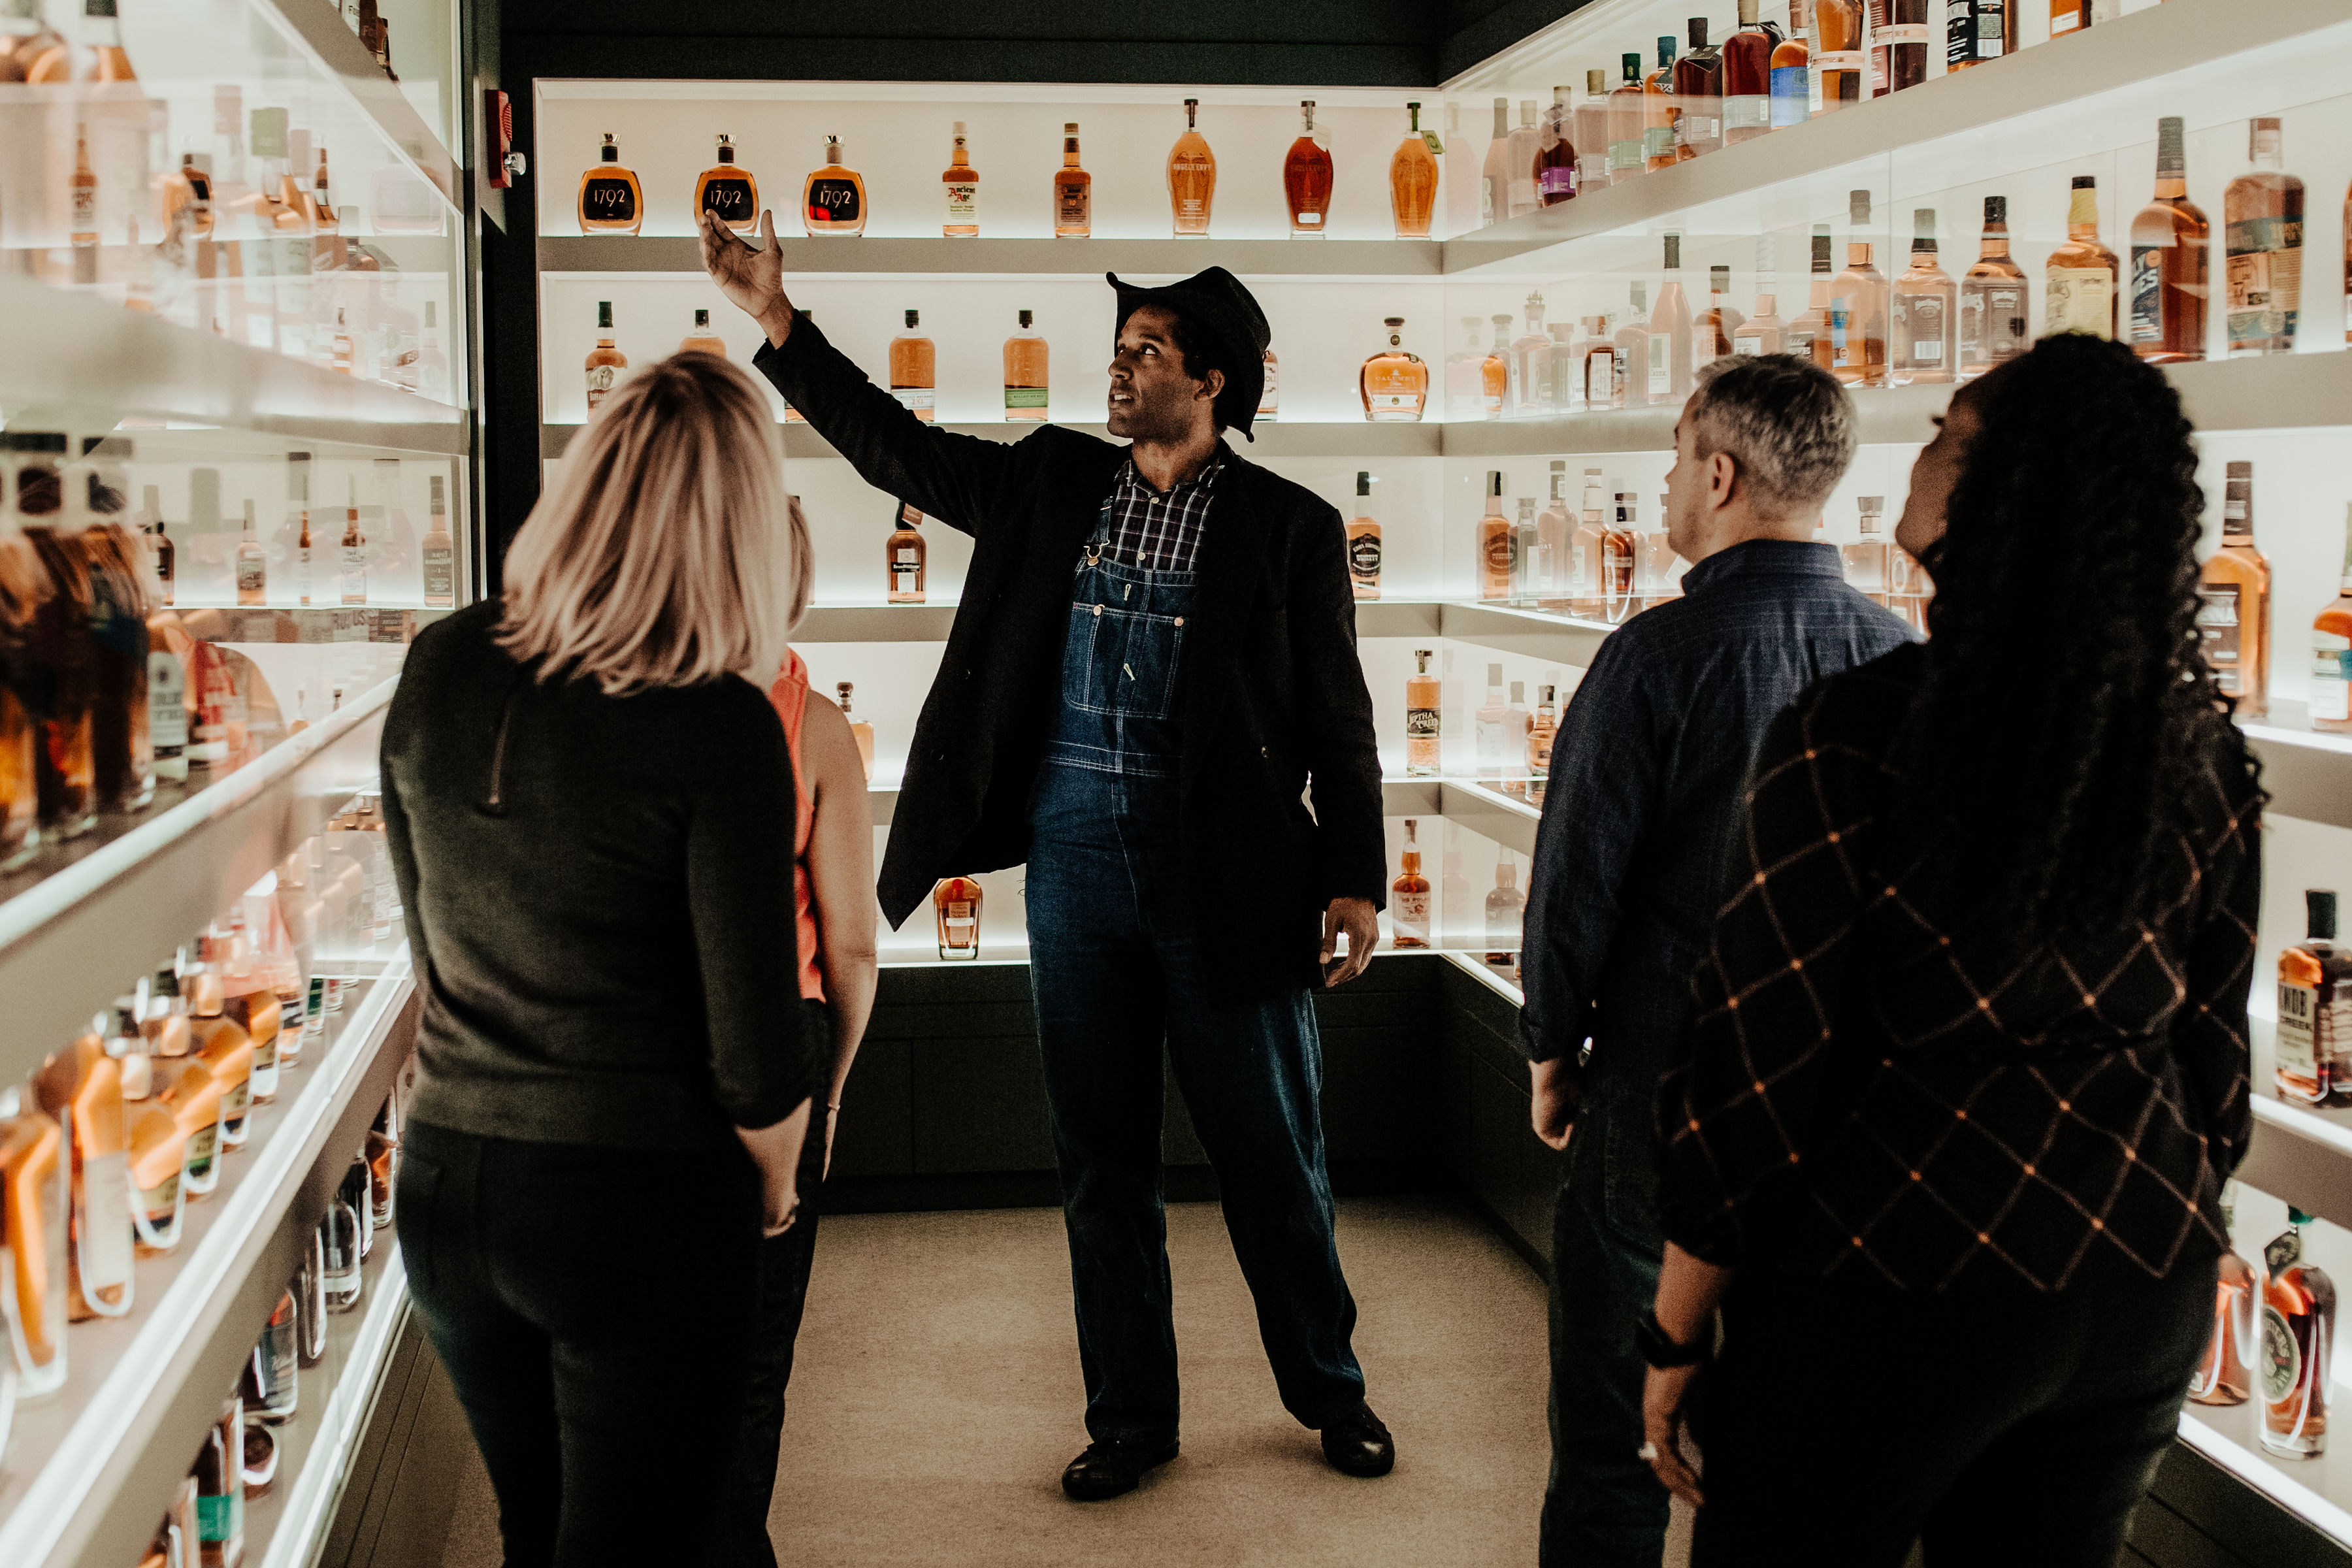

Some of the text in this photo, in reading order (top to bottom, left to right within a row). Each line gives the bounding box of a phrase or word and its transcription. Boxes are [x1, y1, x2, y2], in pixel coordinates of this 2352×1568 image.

[595, 189, 625, 207] 1792
[711, 190, 741, 208] 1792
[820, 191, 851, 208] 1792
[948, 186, 975, 197] Ancient
[954, 193, 970, 203] Age
[1408, 712, 1433, 728] JEPTHA
[1416, 717, 1439, 729] CREED
